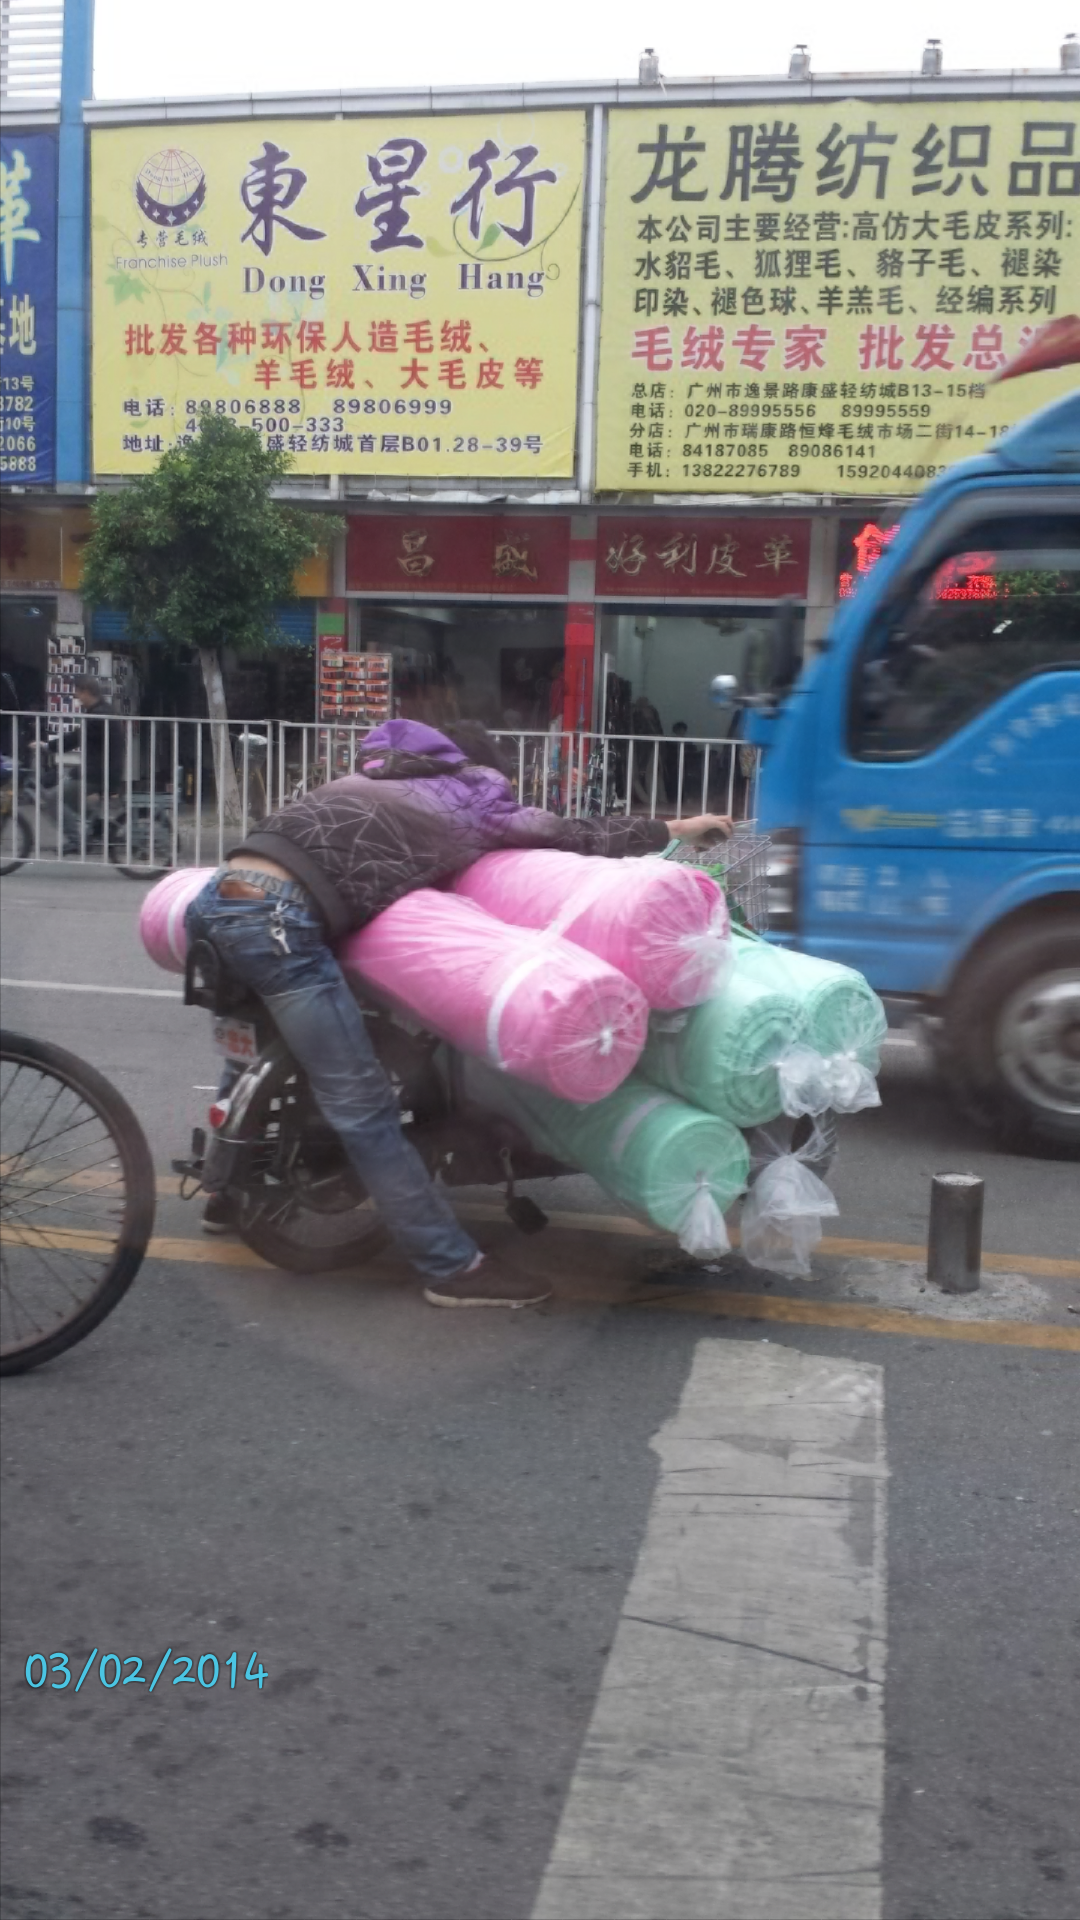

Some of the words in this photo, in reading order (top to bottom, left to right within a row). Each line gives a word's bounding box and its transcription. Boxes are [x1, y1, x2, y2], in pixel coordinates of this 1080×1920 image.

[630, 120, 1080, 203] 龙腾纺织品
[239, 138, 557, 256] 東星行
[115, 254, 187, 270] Franchise
[191, 253, 228, 267] Plush
[242, 265, 326, 299] Dong
[352, 264, 427, 299] Xing
[458, 263, 545, 299] Hang
[124, 319, 493, 357] 批发各种环保人造毛绒、
[631, 323, 828, 372] 毛绒专家
[859, 323, 1034, 372] 批发总
[254, 356, 545, 391] 羊毛绒、大毛皮等
[123, 398, 174, 417] 电话:
[185, 398, 301, 415] 89806888
[333, 398, 452, 415] 89806999
[631, 402, 674, 419] 电话:
[684, 403, 817, 418] 020-89995556
[841, 403, 931, 418] 89995559
[629, 442, 671, 459] 电话:
[682, 443, 769, 458] 84187085
[788, 443, 876, 458] 89086141
[682, 463, 801, 478] 13822276789
[605, 531, 798, 579] 好利皮革
